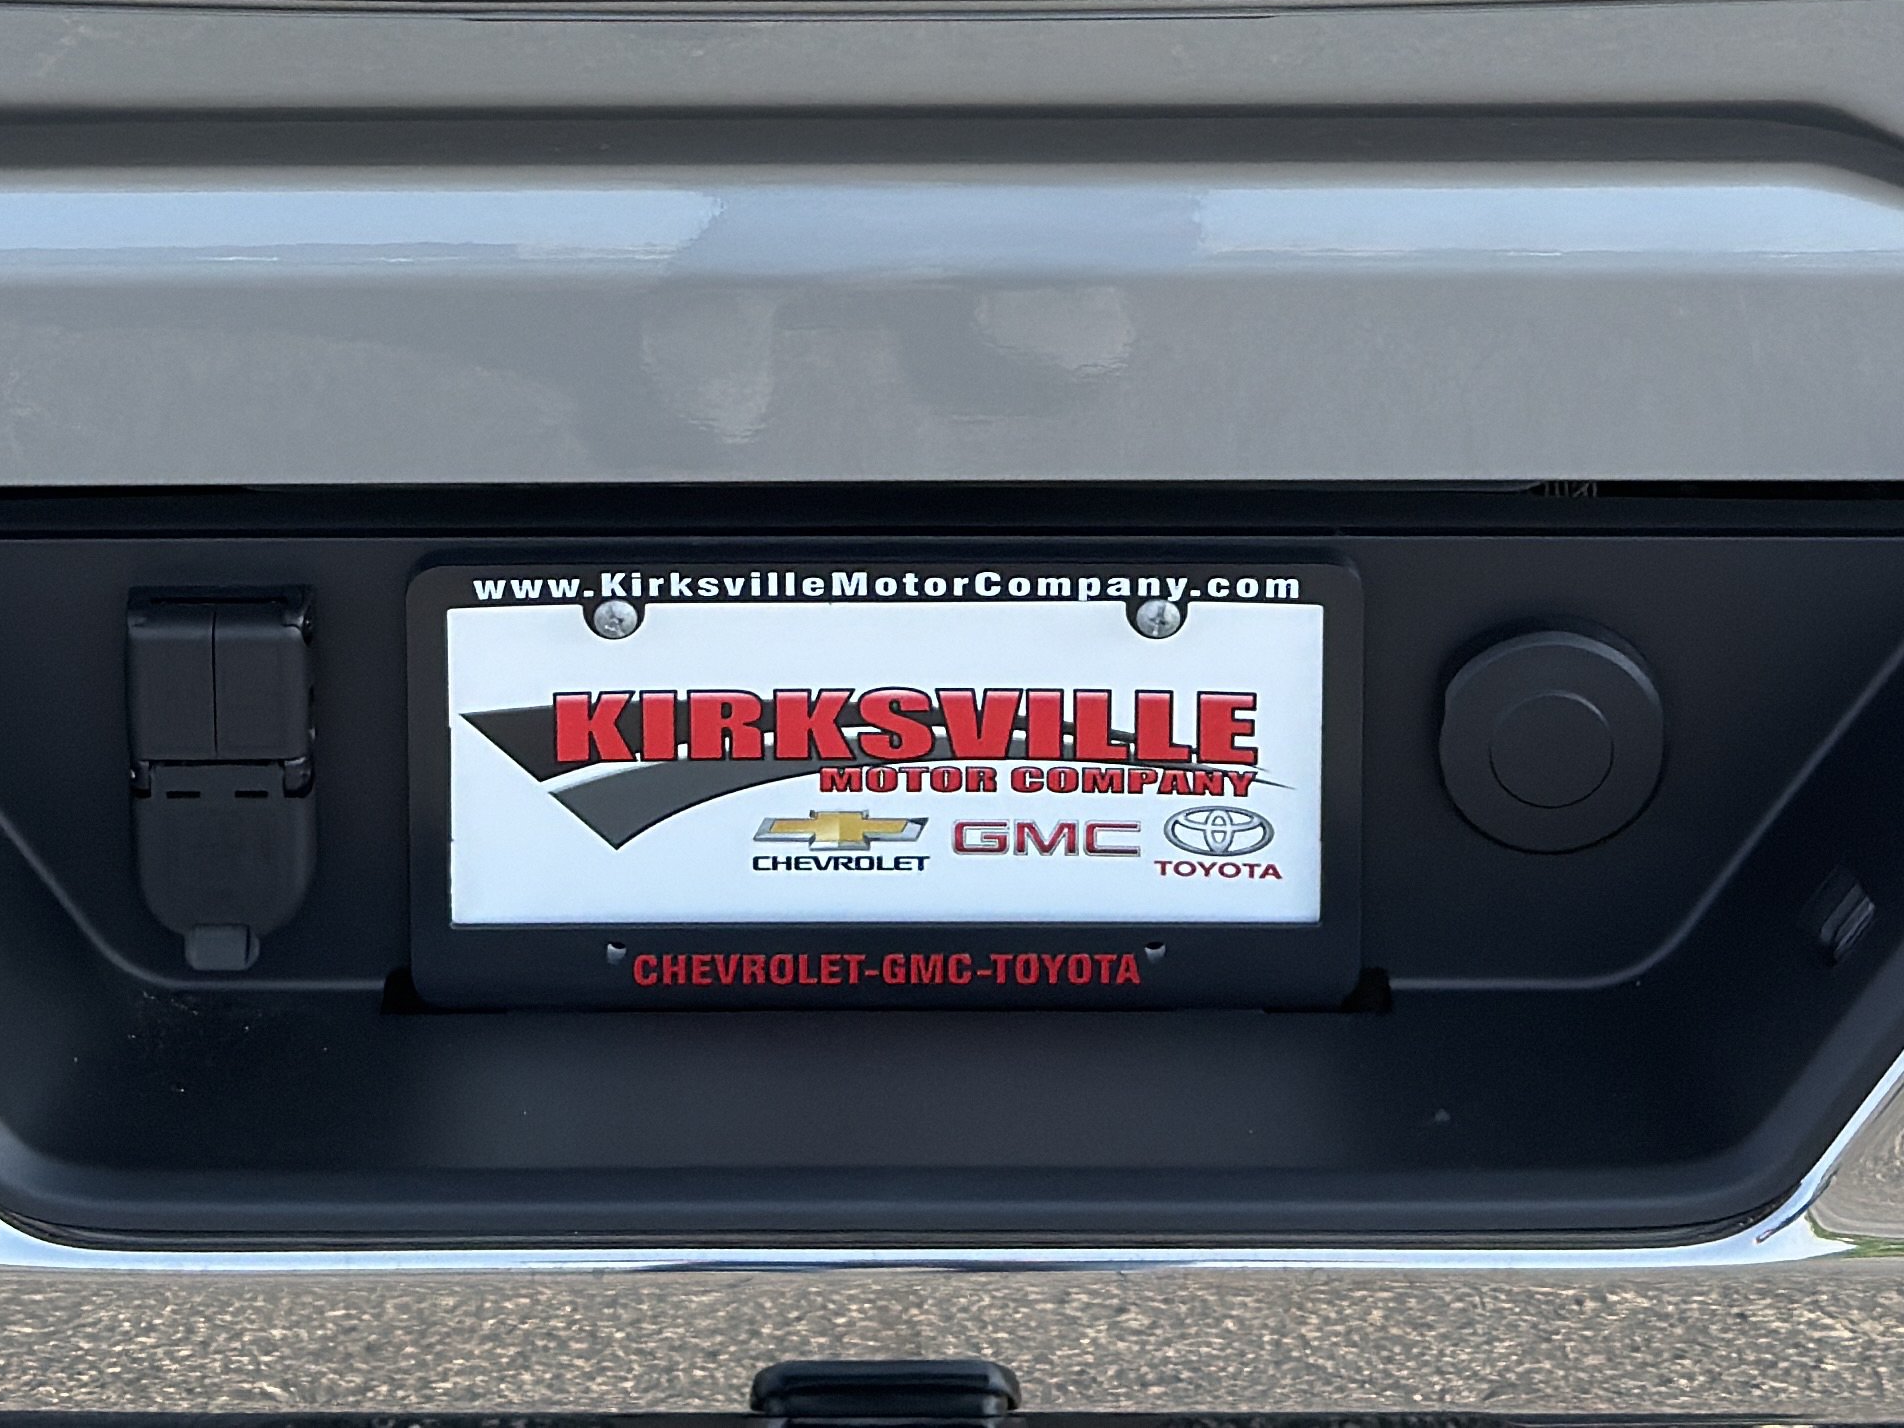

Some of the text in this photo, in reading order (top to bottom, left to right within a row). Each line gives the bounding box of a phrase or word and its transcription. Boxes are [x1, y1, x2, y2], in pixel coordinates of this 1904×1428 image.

[472, 571, 1300, 602] www.KirksvilleMotorCompany.com
[552, 686, 1260, 765] KIRKSVILLE
[819, 766, 1257, 797] MOTOR COMPANY
[951, 817, 1142, 858] GMC
[751, 854, 931, 873] CHEVROLET
[1153, 859, 1284, 881] TOYOTA
[632, 953, 1141, 986] CHEVROLET-GMC-TOYOTA
